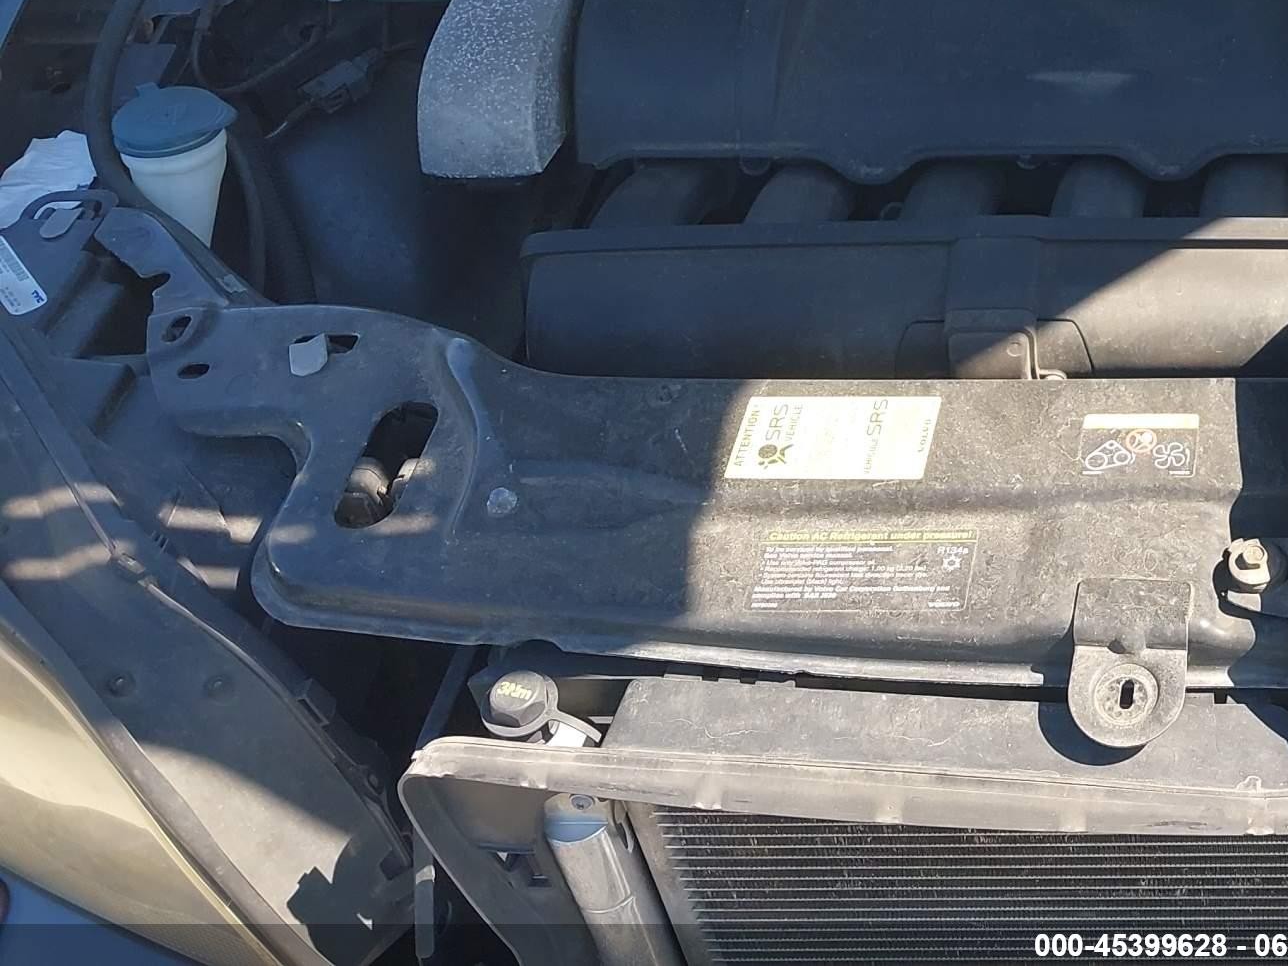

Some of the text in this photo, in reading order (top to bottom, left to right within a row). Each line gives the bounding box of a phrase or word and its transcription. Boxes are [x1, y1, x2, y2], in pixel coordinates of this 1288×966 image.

[765, 403, 789, 442] SRS
[785, 403, 804, 442] VEHICLE
[866, 398, 889, 436] SRS
[768, 532, 811, 541] Caution
[813, 532, 829, 540] AC
[829, 531, 889, 542] Refrigerant
[890, 532, 922, 540] under
[937, 545, 969, 555] R134a
